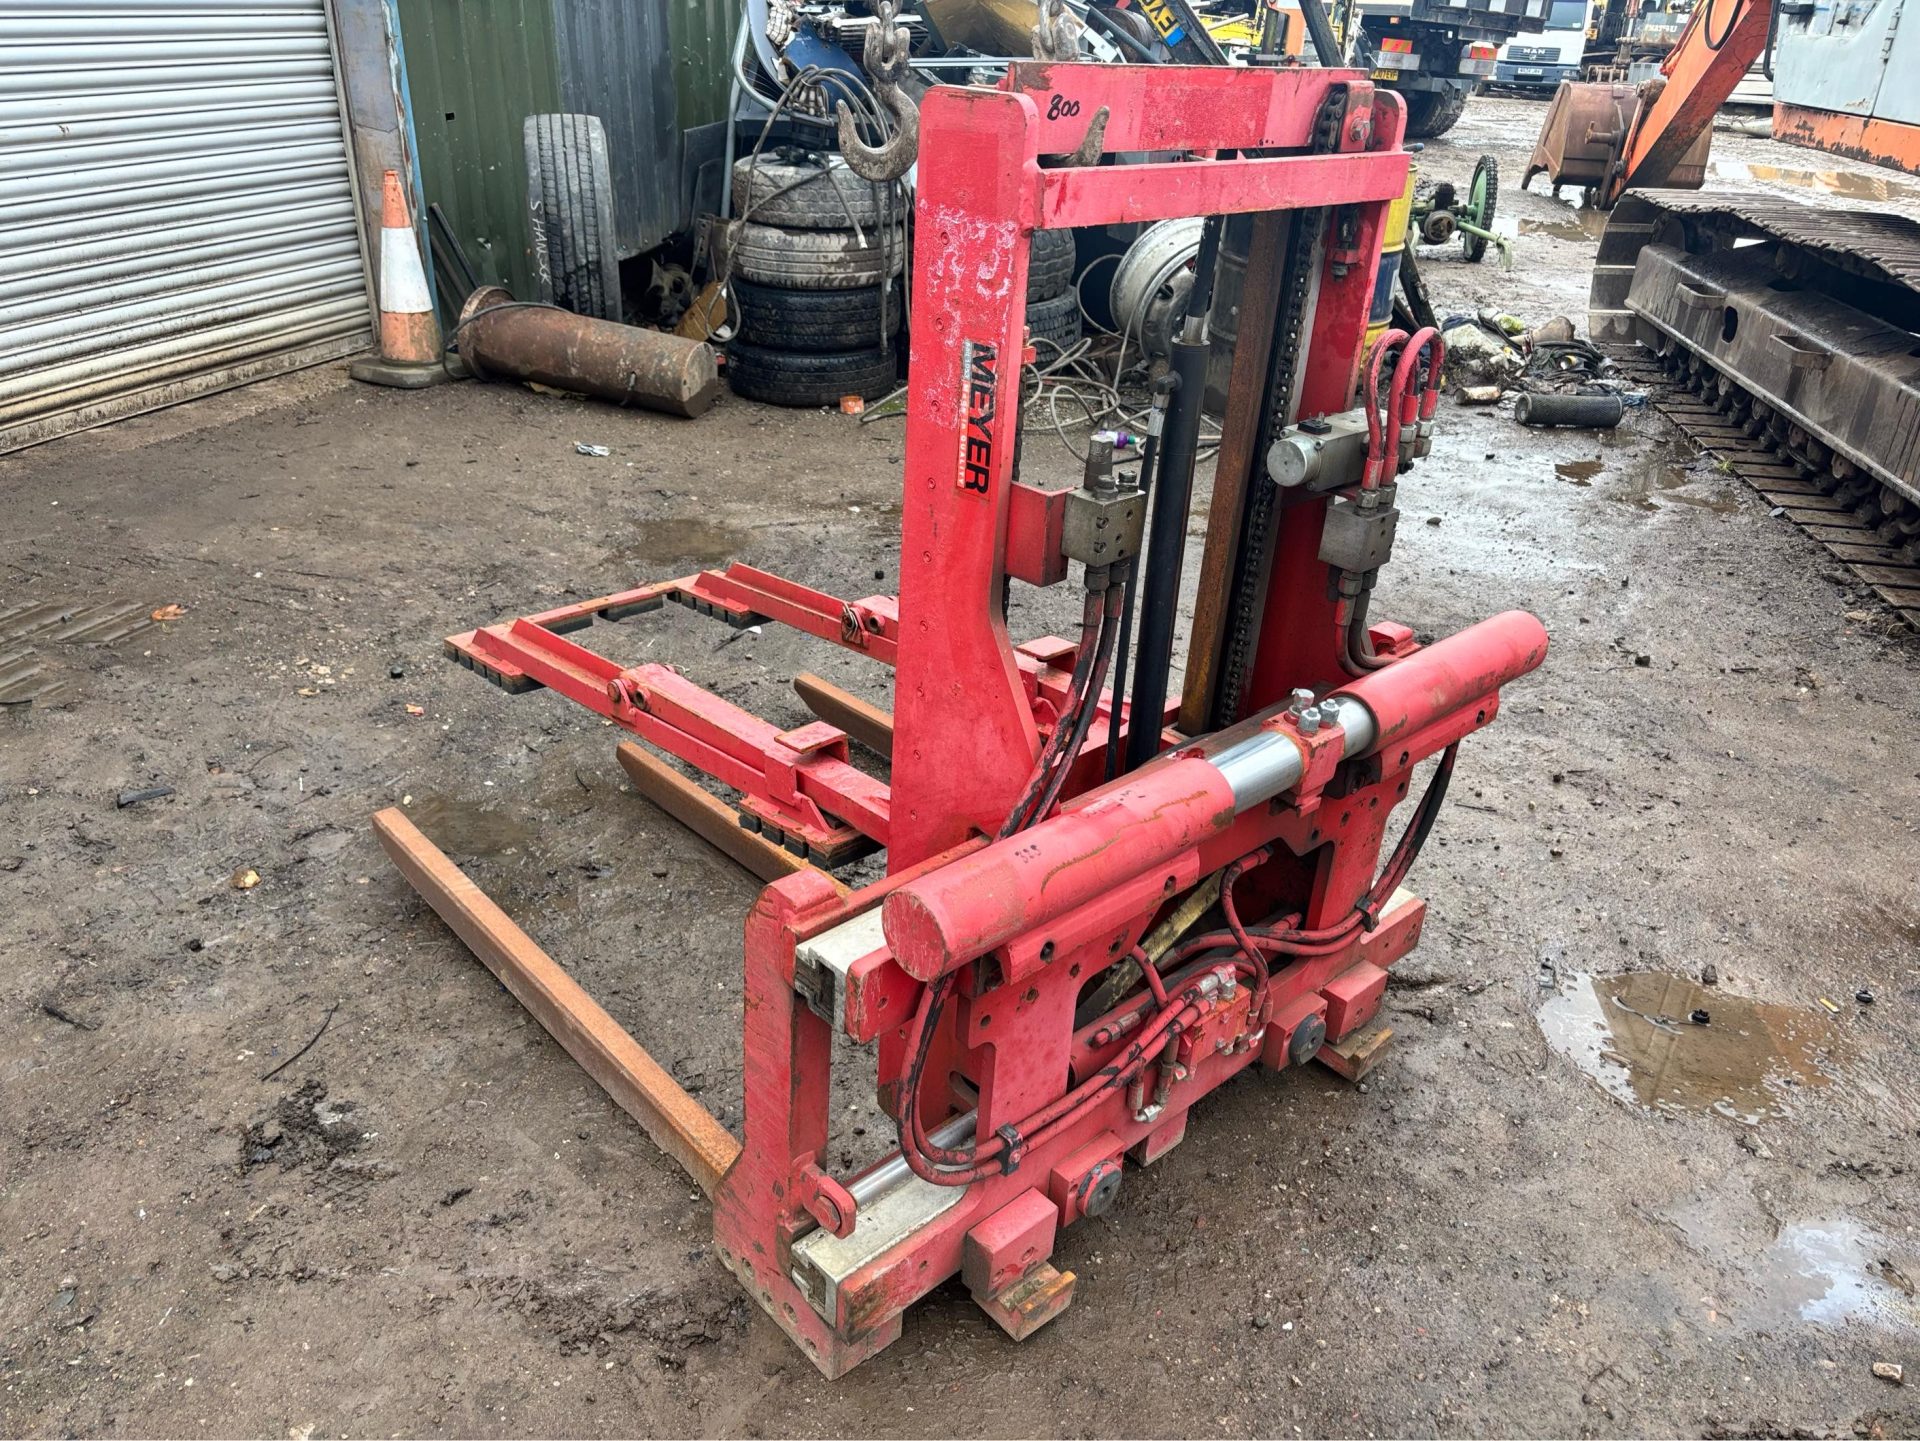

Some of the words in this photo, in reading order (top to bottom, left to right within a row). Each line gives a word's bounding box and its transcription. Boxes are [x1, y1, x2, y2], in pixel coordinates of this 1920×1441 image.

[1047, 94, 1080, 121] 800
[965, 342, 996, 494] MEYER
[959, 435, 967, 486] QUALITY
